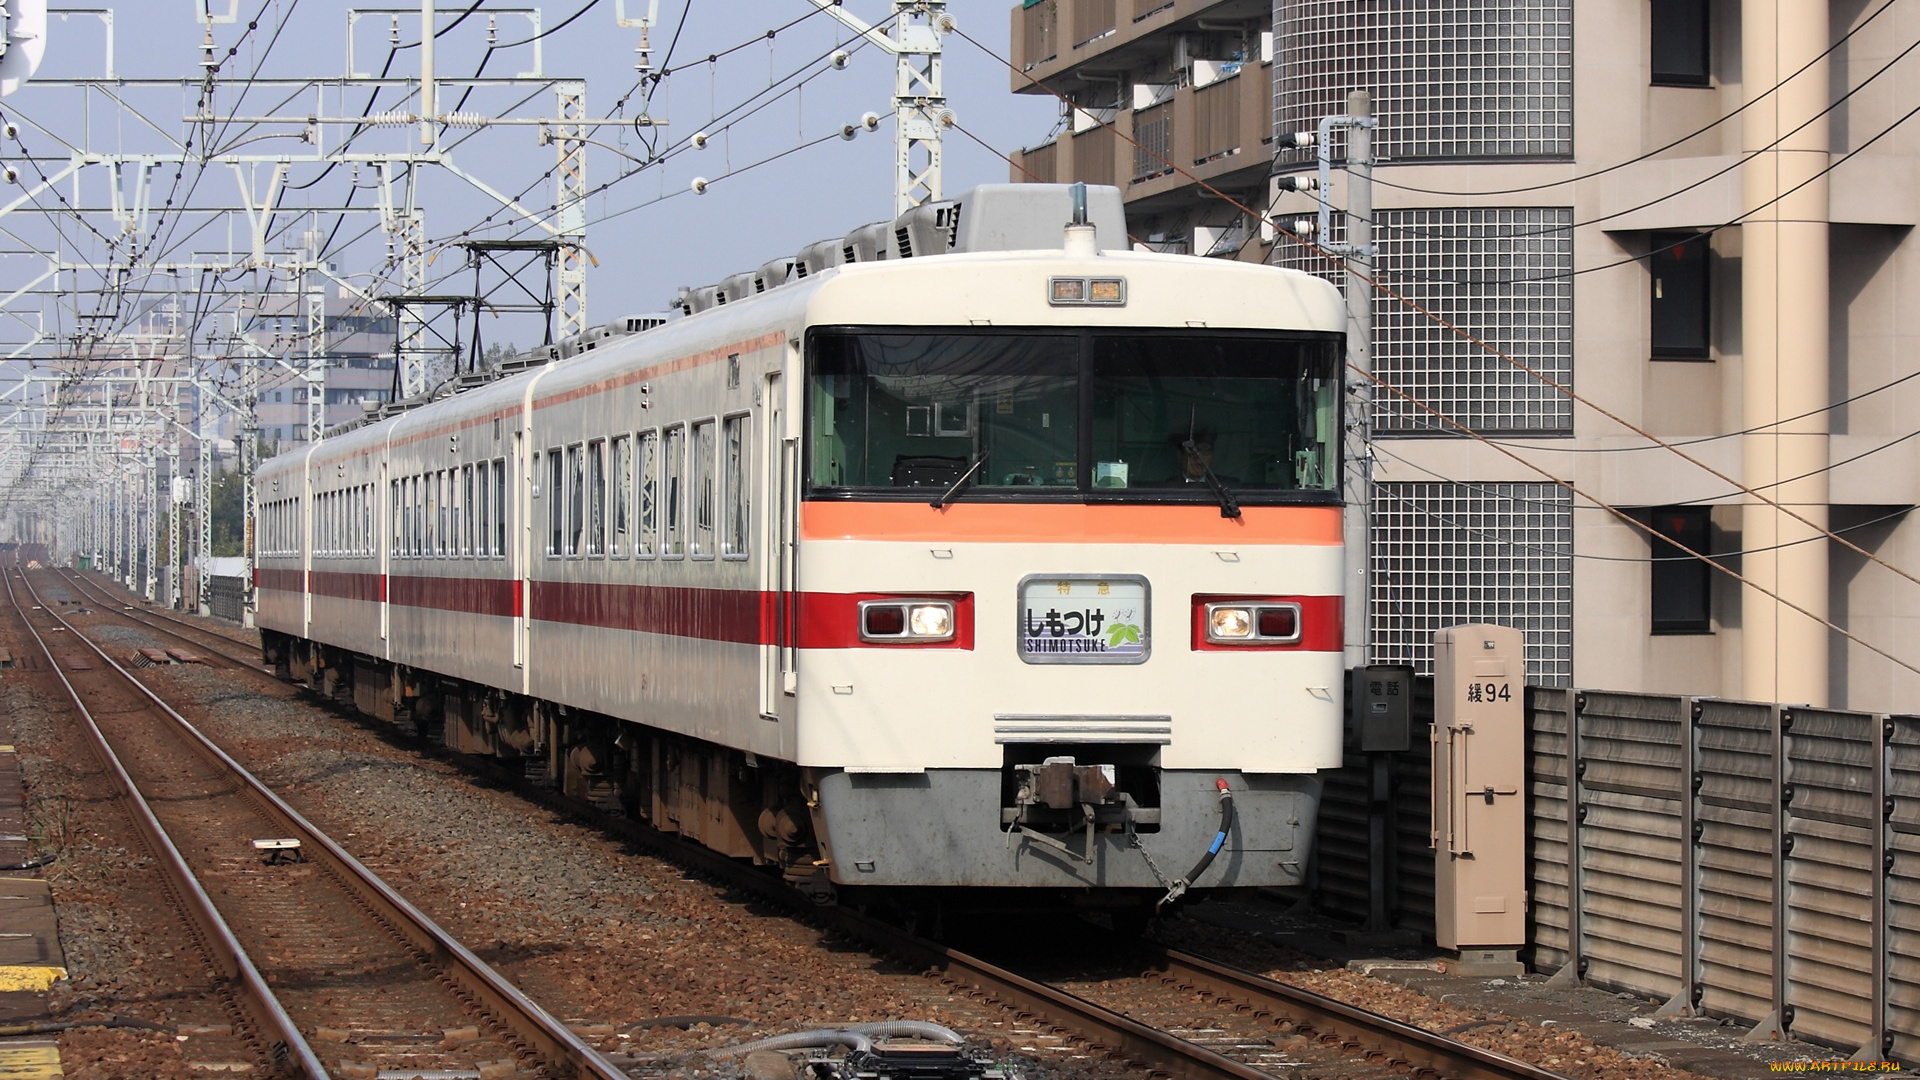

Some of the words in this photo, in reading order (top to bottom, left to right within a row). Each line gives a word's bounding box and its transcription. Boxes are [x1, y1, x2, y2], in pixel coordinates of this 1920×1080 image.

[1057, 581, 1110, 595] 特急
[1027, 608, 1105, 638] しもつけ
[1027, 638, 1106, 653] SHIMOTSUKE
[1370, 681, 1400, 696] 電話
[1467, 683, 1511, 703] 緩94
